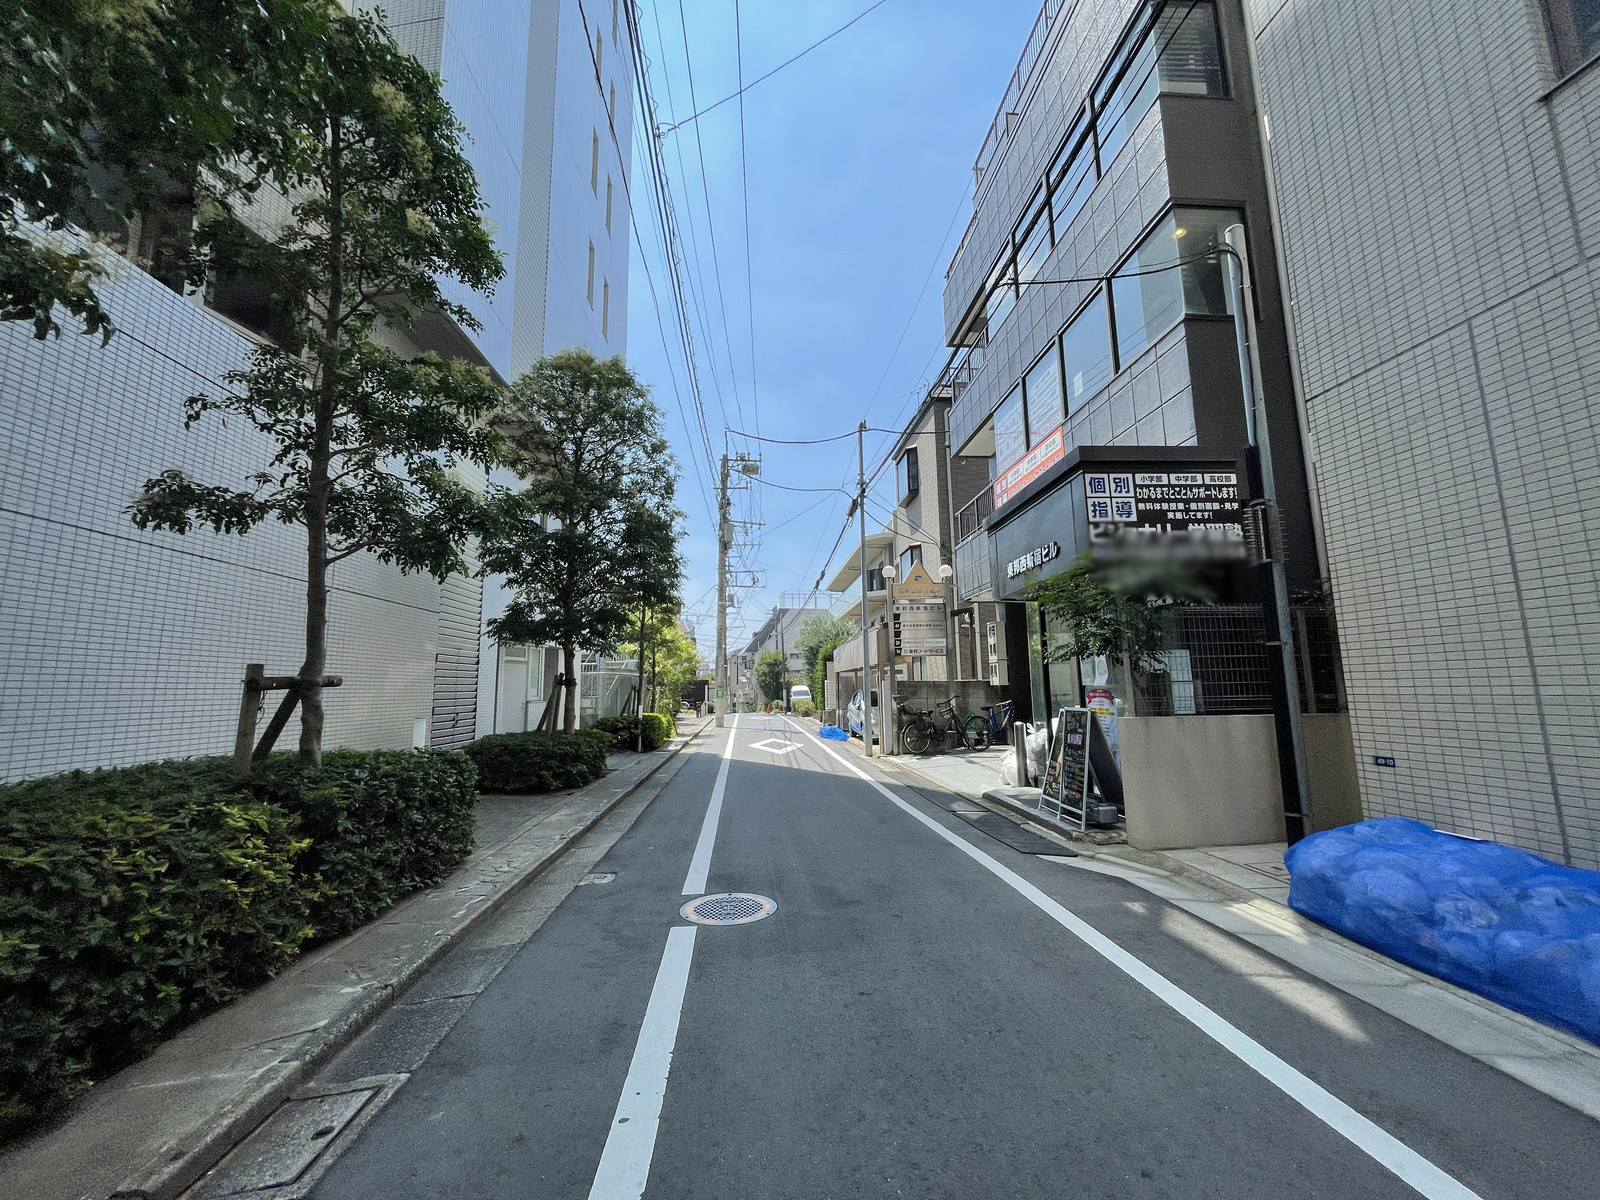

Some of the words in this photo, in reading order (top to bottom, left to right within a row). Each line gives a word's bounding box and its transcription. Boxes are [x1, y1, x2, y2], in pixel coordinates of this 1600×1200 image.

[1140, 475, 1163, 483] 小学部
[1174, 475, 1198, 483] 中学部
[1208, 475, 1232, 483] 高校部
[1088, 476, 1131, 494] 個別
[1135, 486, 1239, 500] わかるまでとことんサポートします!
[1091, 501, 1134, 519] 指導
[1166, 511, 1213, 520] 実施してます!
[1006, 541, 1058, 579] 東邦西新宿ビル
